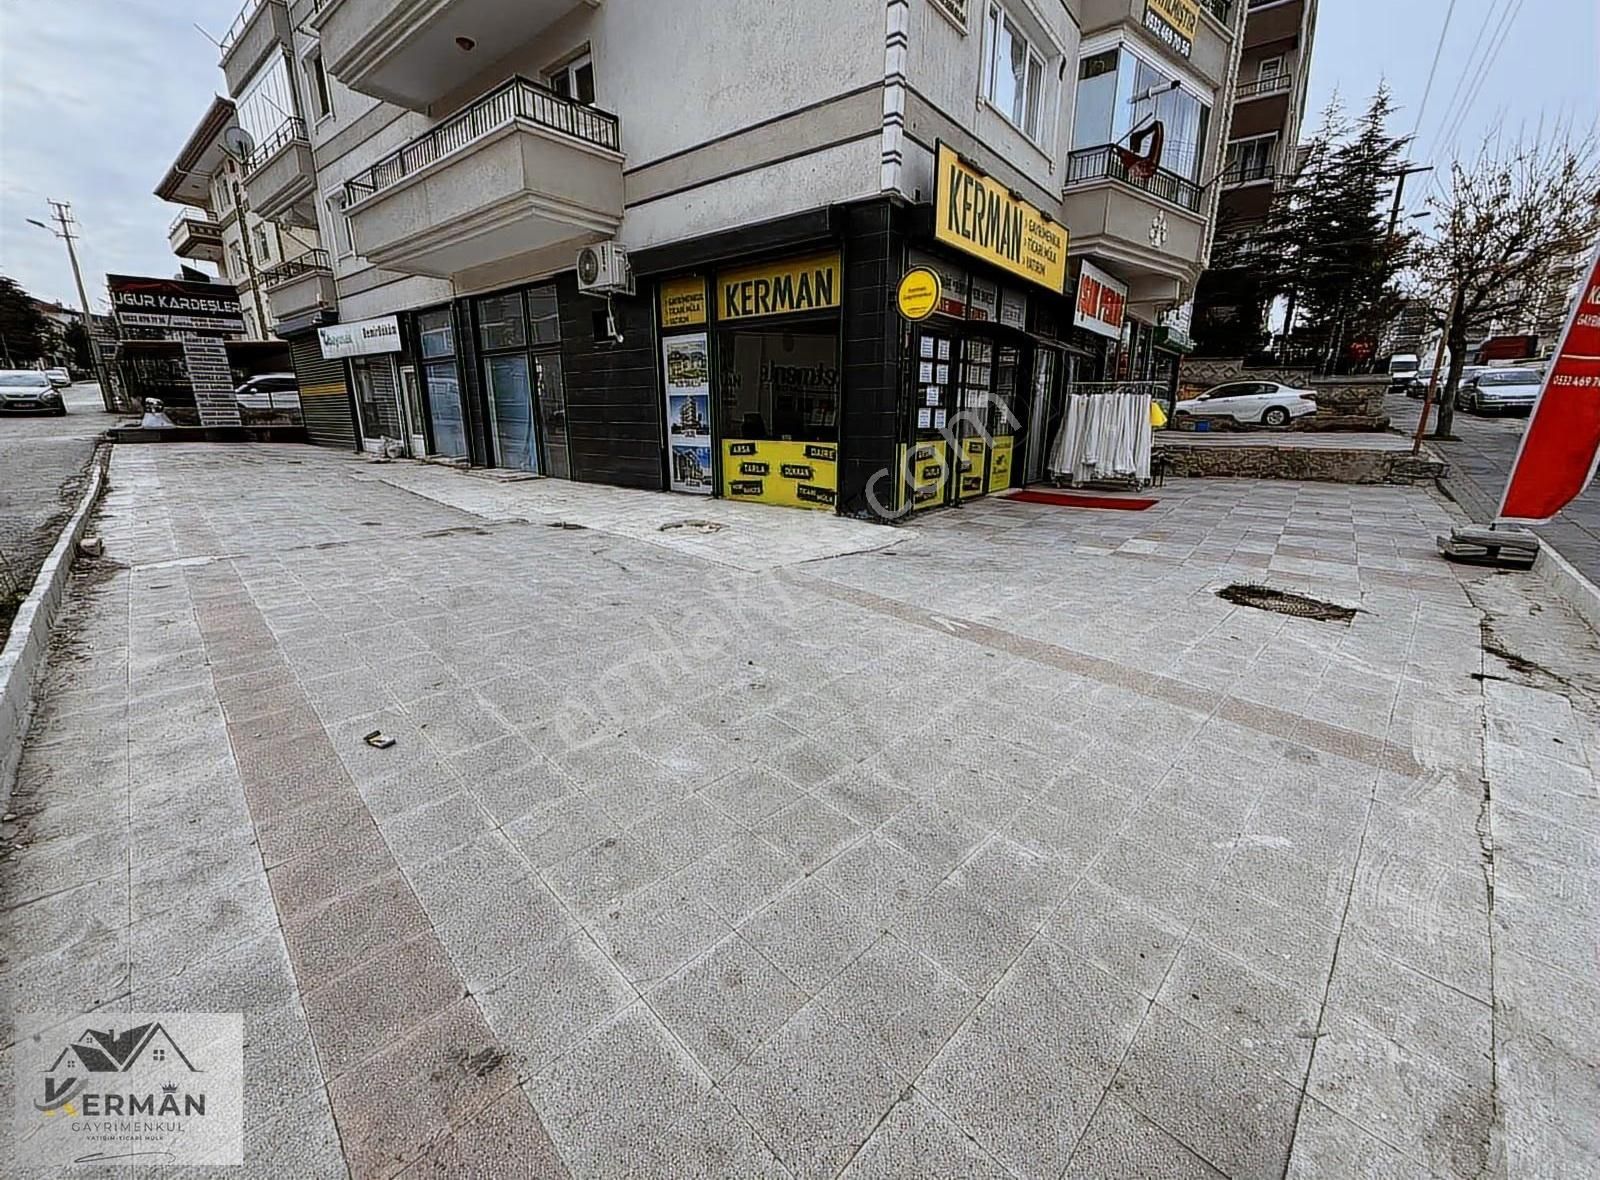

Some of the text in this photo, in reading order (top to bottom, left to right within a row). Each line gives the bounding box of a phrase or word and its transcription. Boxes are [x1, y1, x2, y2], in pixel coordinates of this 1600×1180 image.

[948, 164, 1023, 264] KERMAN
[158, 295, 242, 314] KARDEŞLER
[725, 268, 833, 318] KERMAN
[1553, 375, 1572, 386] 0532
[1573, 376, 1591, 387] 469
